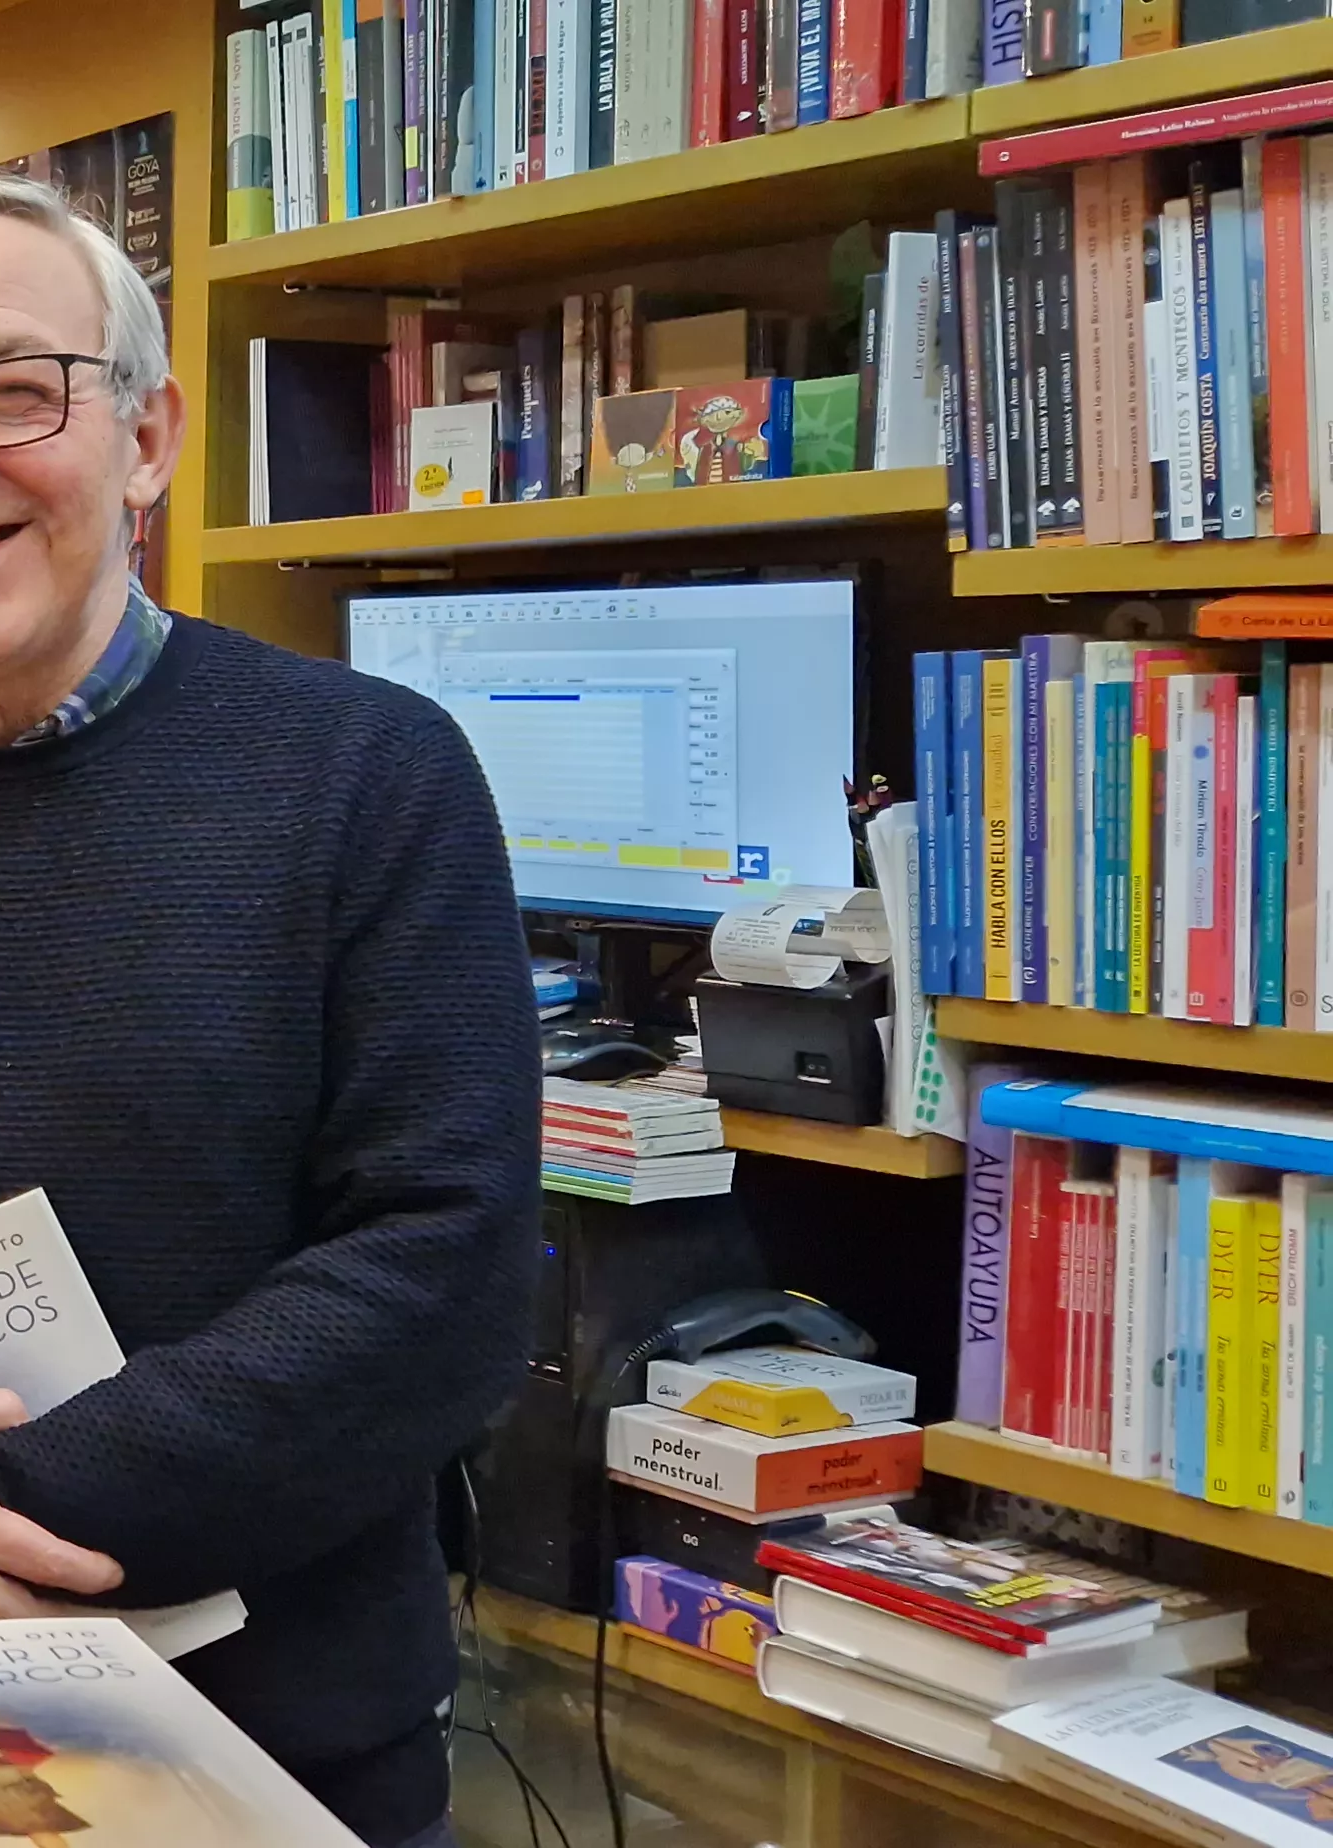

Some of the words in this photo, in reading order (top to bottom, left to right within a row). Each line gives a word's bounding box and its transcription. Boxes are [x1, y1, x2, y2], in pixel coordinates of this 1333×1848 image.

[599, 27, 614, 45] LA
[800, 24, 821, 45] EL
[599, 47, 614, 57] Y
[599, 58, 614, 92] BALA
[800, 48, 822, 92] ¡VIVA
[598, 93, 613, 112] LA
[128, 158, 160, 180] GOYA
[1191, 215, 1206, 240] 1911
[940, 238, 950, 272] CORRAL
[1193, 243, 1207, 278] muerte
[914, 277, 929, 294] de
[942, 273, 951, 292] LUIS
[1194, 291, 1208, 306] de
[942, 294, 952, 313] JOSÉ
[914, 298, 928, 354] corridas
[1172, 284, 1189, 382] MONTESCOS
[1195, 307, 1210, 360] Centenario
[912, 358, 924, 380] Las
[521, 364, 539, 441] Periquetes
[1036, 366, 1049, 407] SEÑORAS
[1176, 390, 1190, 399] Y
[1196, 372, 1213, 416] COSTA
[984, 423, 996, 449] GALÁN
[1008, 408, 1021, 440] Manuel
[1037, 417, 1050, 448] DAMAS
[1062, 413, 1075, 445] DAMAS
[1198, 420, 1216, 481] JOAQUÍN
[1027, 652, 1039, 700] MAESTRA
[1027, 702, 1038, 716] MI
[1027, 718, 1038, 743] CON
[1028, 745, 1038, 841] CONVERSACIONES
[1196, 779, 1208, 820] Miriam
[990, 819, 1007, 864] ELLOS
[1196, 822, 1208, 858] Tirado
[990, 868, 1007, 898] CON
[990, 901, 1007, 949] HABLA
[1023, 906, 1035, 961] CATHERINE
[967, 1147, 1007, 1345] AUTOAYUDA
[1288, 1228, 1298, 1272] FROMM
[1212, 1229, 1234, 1300] DYER
[1257, 1232, 1280, 1305] DYER
[1288, 1272, 1297, 1306] ERICH
[652, 1436, 701, 1462] poder
[822, 1450, 864, 1470] poder
[633, 1454, 724, 1492] menstrual.
[26, 1630, 98, 1642] OTTO
[49, 1643, 120, 1661] DE
